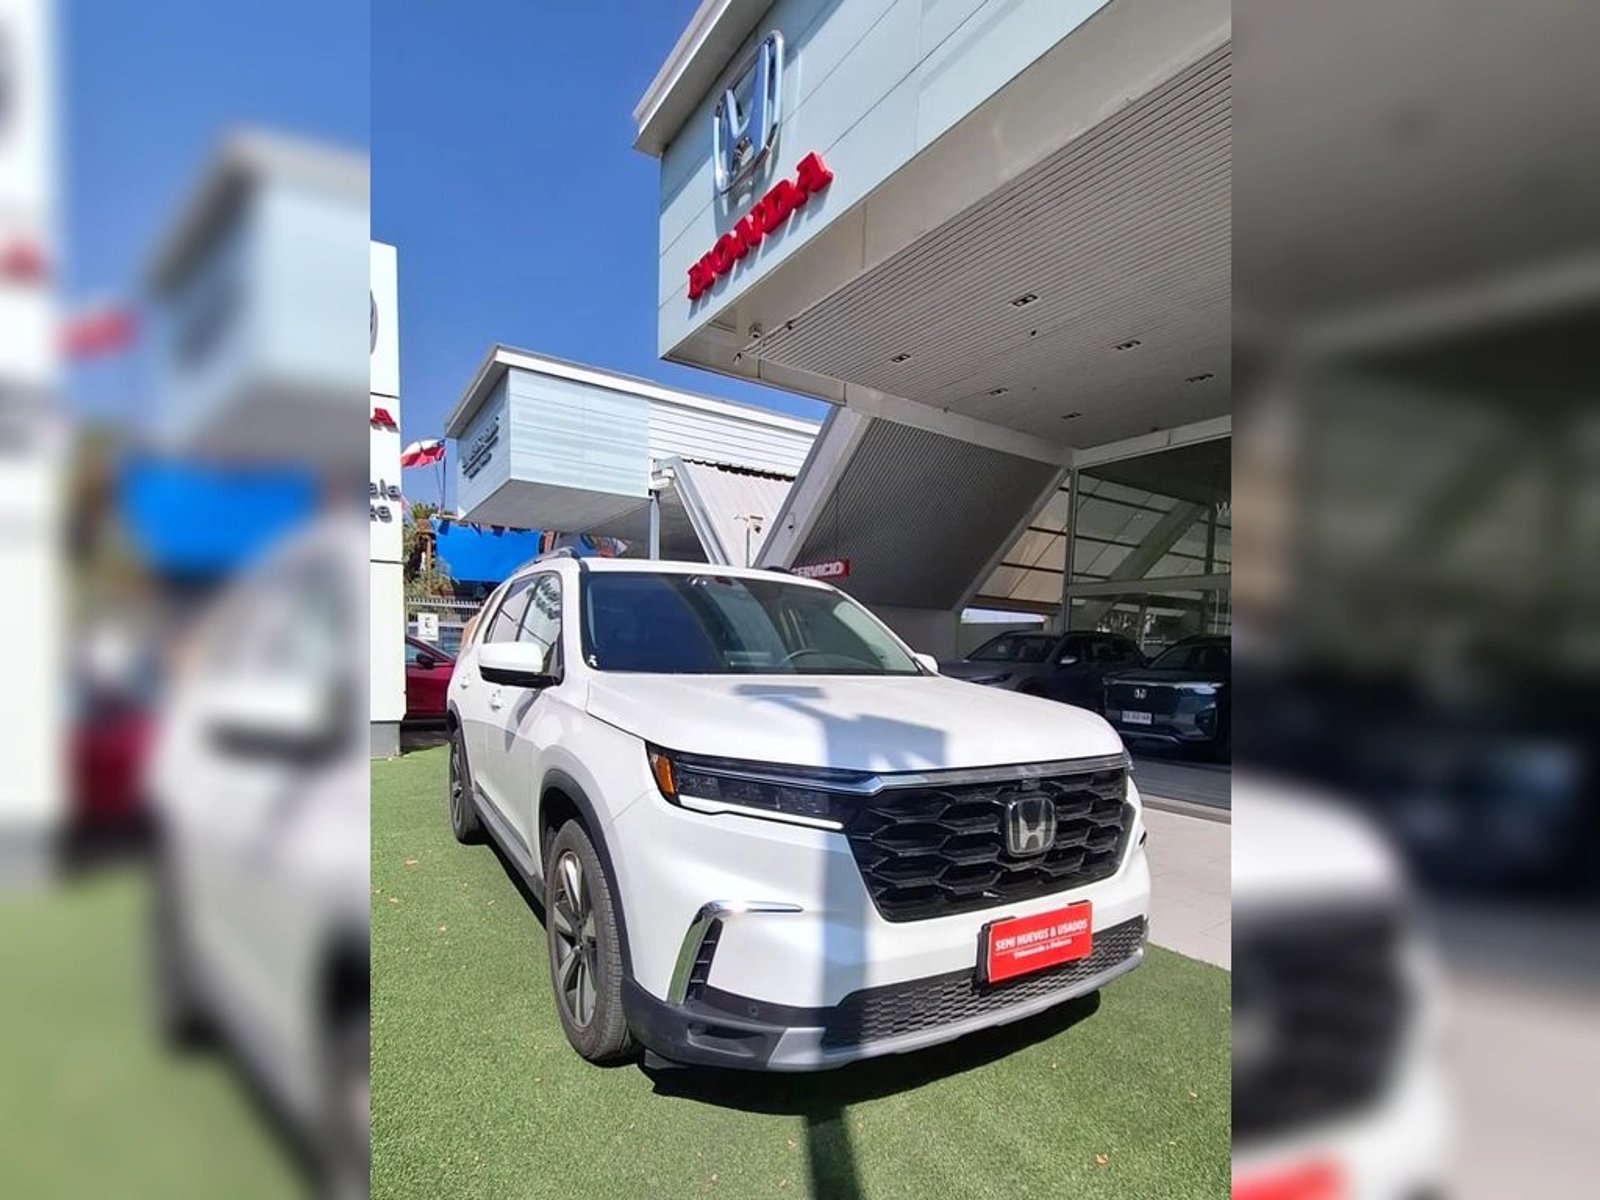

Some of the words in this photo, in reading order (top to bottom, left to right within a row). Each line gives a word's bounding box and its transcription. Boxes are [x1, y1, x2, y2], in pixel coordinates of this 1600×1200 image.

[687, 152, 834, 300] HONDA
[995, 937, 1016, 951] SEMI
[1017, 927, 1049, 946] NUEVOS
[1058, 919, 1088, 936] USADOS
